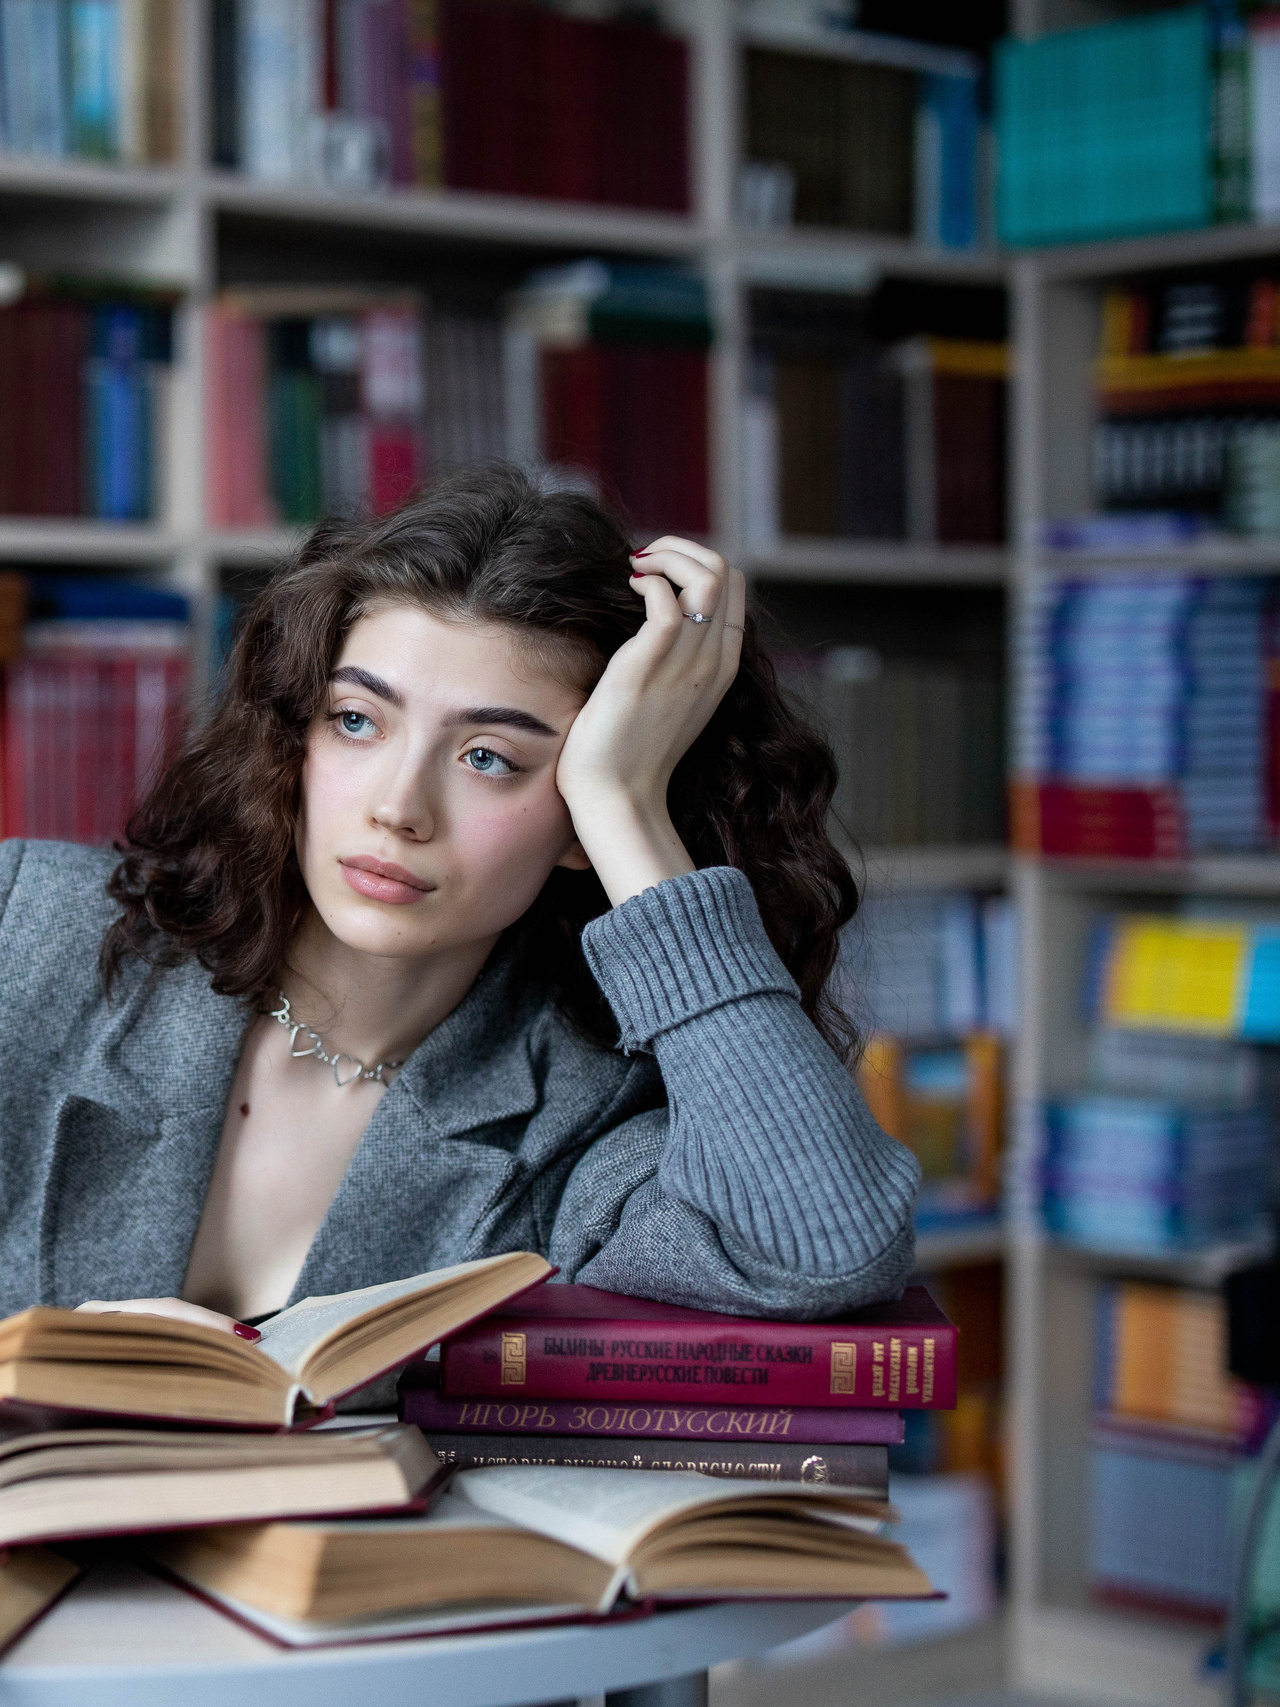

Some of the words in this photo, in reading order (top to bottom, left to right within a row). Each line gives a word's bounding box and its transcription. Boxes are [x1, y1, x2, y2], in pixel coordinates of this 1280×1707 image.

[676, 1342, 752, 1363] НАРОДНЫЕ
[757, 1344, 813, 1364] СКАЗКИ
[888, 1337, 901, 1402] ЛИТЕРАТУРЫ
[586, 1362, 701, 1384] ДРЕВНЕРУССКИЕ
[704, 1366, 768, 1385] ПОВЕСТИ
[872, 1364, 886, 1397] ДЕТЕЙ
[906, 1346, 919, 1394] МИРОВОЙ
[921, 1338, 935, 1403] БИБЛИОТЕКА
[455, 1403, 556, 1428] ИГОРЬ
[567, 1406, 794, 1435] ЗОЛОТУССКИЙ
